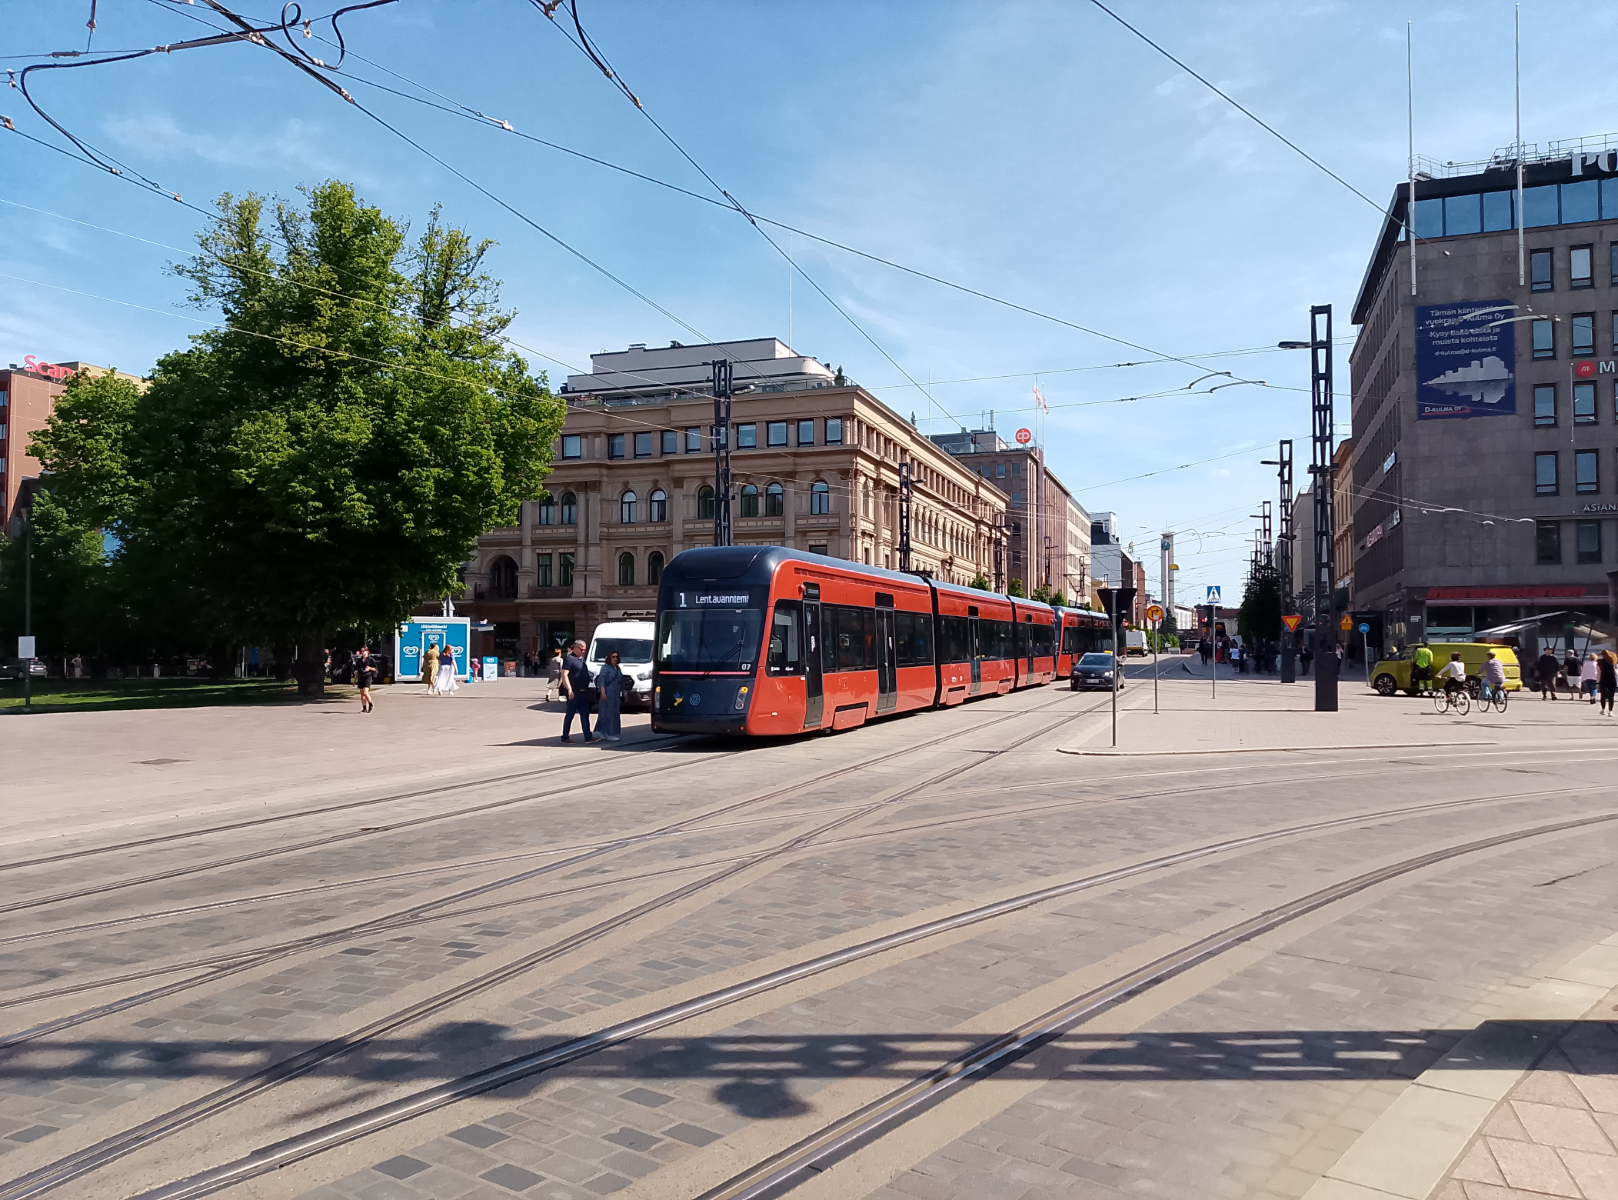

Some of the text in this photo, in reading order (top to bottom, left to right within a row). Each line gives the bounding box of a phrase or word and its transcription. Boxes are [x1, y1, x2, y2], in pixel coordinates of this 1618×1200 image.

[1430, 330, 1449, 339] Kysy
[1461, 335, 1498, 343] kohteista
[1583, 503, 1618, 512] ASIAN
[679, 592, 687, 608] 1
[741, 663, 751, 671] 07
